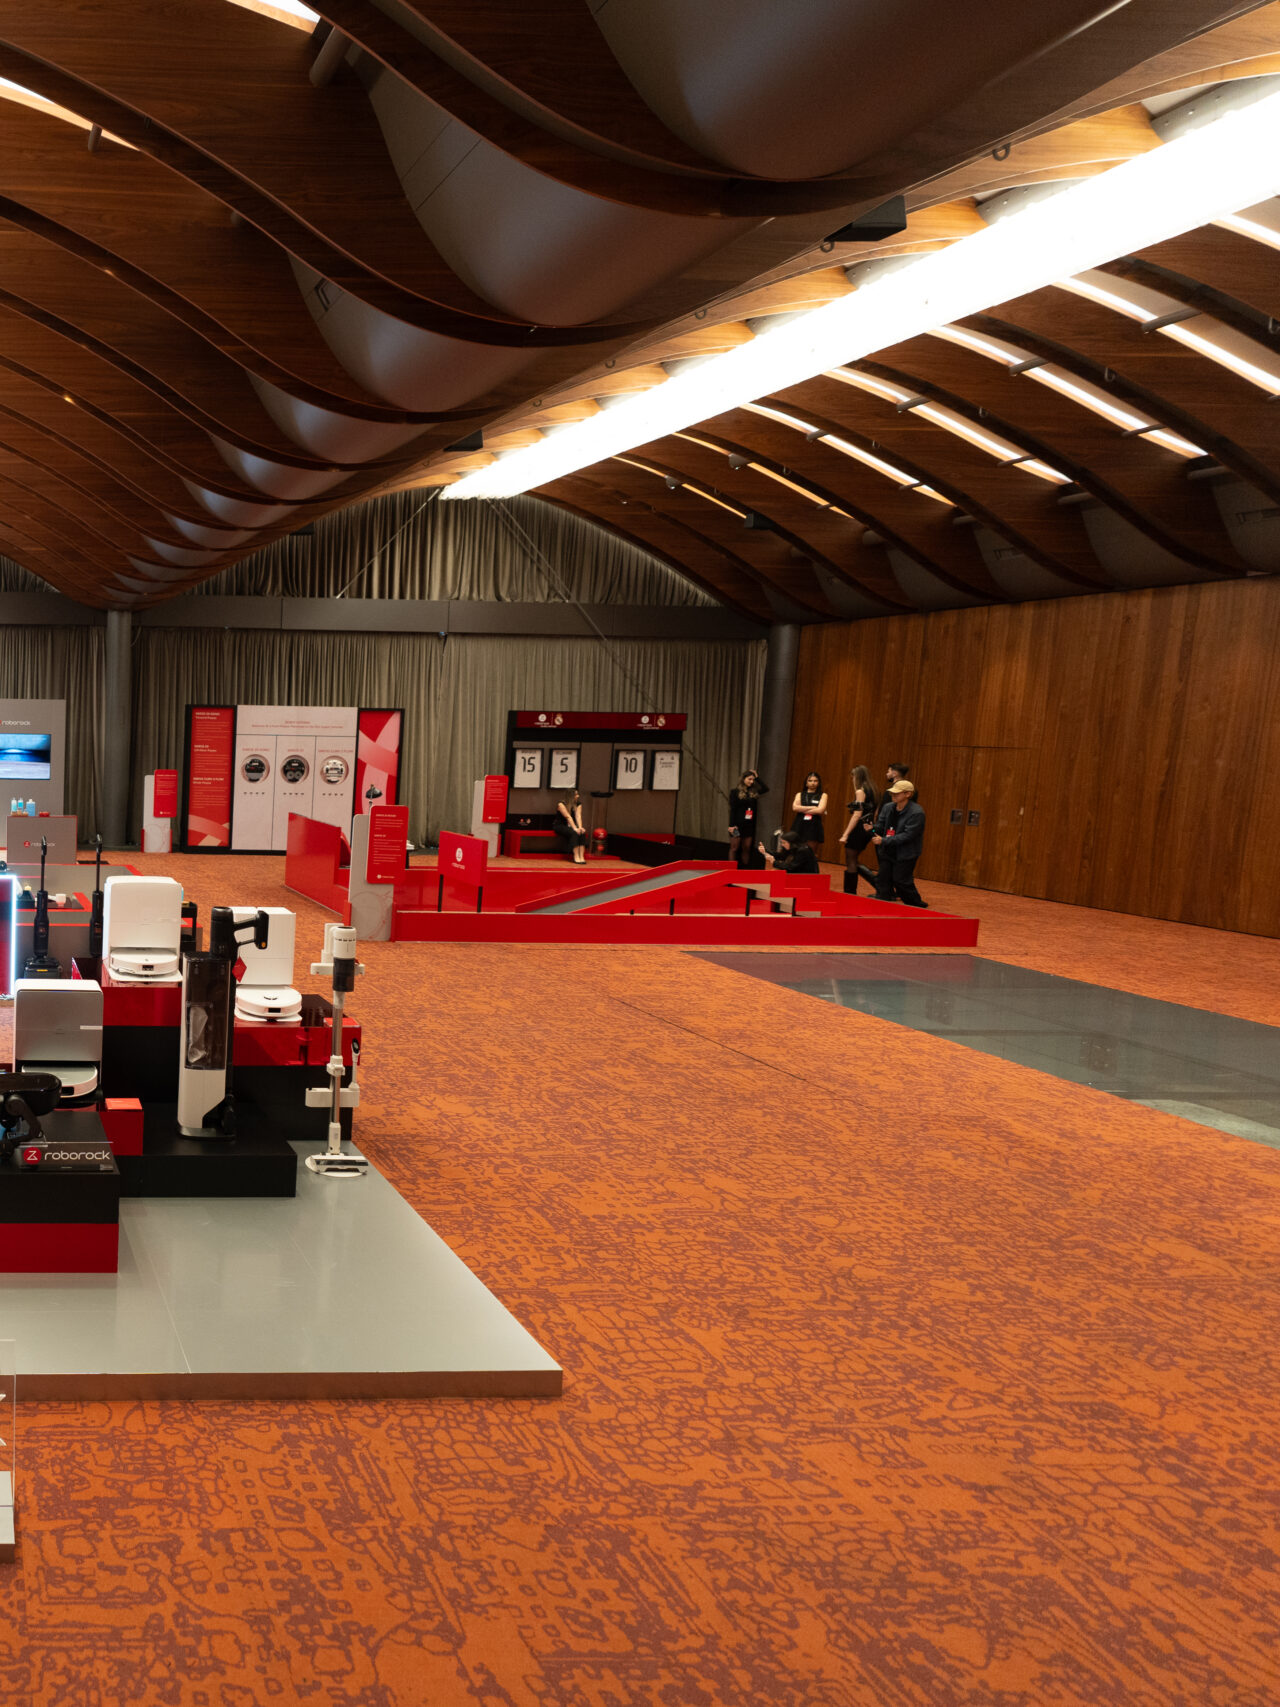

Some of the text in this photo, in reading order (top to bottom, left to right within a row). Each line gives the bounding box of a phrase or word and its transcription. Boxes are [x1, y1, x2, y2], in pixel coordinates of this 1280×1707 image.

[521, 756, 536, 773] 15
[560, 757, 569, 773] 5
[623, 757, 638, 773] 10
[44, 1150, 110, 1161] roborock
